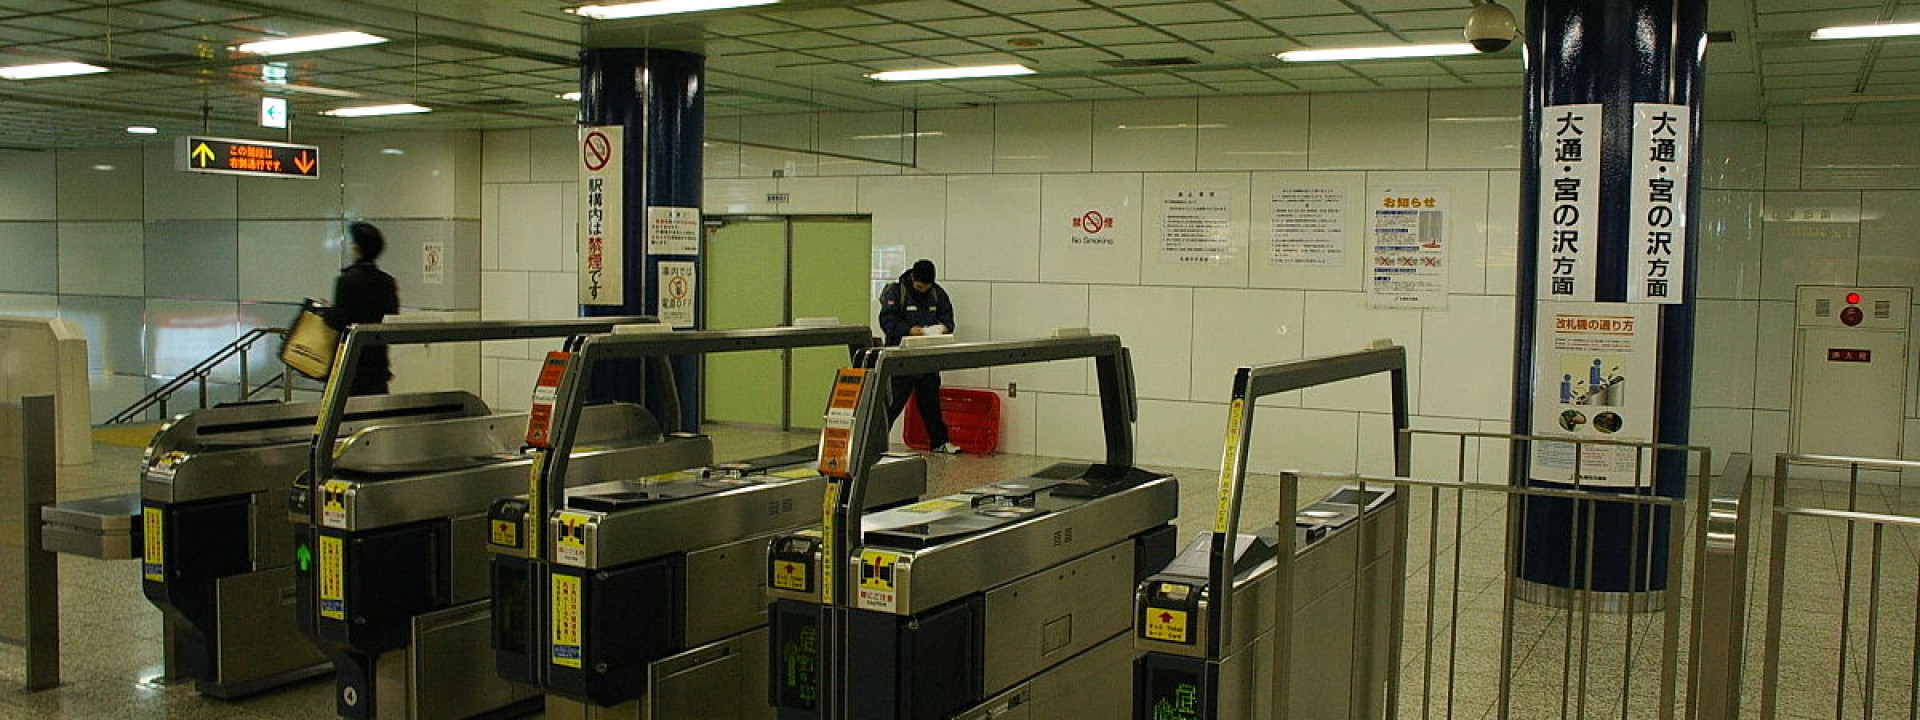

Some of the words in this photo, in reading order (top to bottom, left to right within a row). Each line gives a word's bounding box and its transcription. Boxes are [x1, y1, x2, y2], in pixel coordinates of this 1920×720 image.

[588, 178, 603, 300] 駅構内は禁煙です
[1383, 197, 1436, 209] お知らせ
[1552, 111, 1584, 296] 大通・宮の沢方面
[1647, 111, 1677, 298] 大通・宮の沢方面
[1556, 317, 1635, 332] 改札機の通り方
